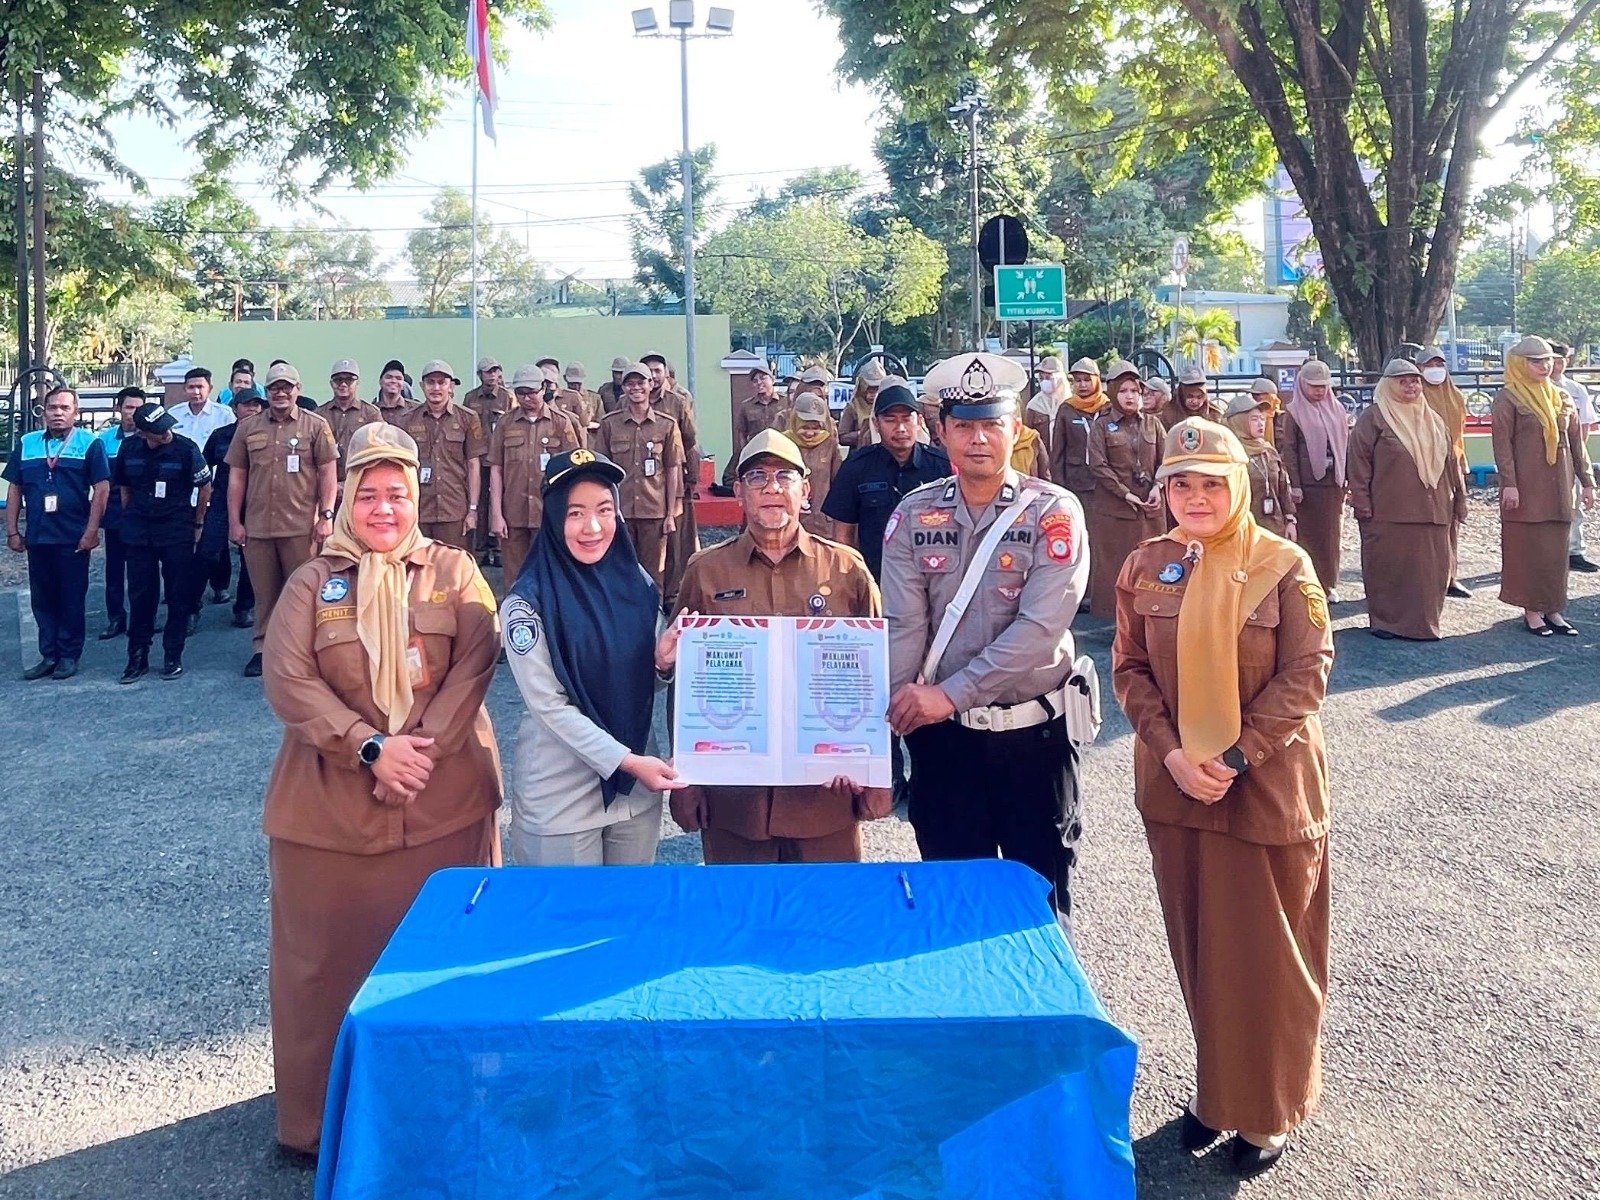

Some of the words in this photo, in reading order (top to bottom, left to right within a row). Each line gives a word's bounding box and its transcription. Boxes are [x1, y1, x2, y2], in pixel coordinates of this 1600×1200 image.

[914, 531, 958, 546] DIAN
[706, 651, 742, 659] MAKLUMAT
[822, 661, 859, 669] PELAYANAN
